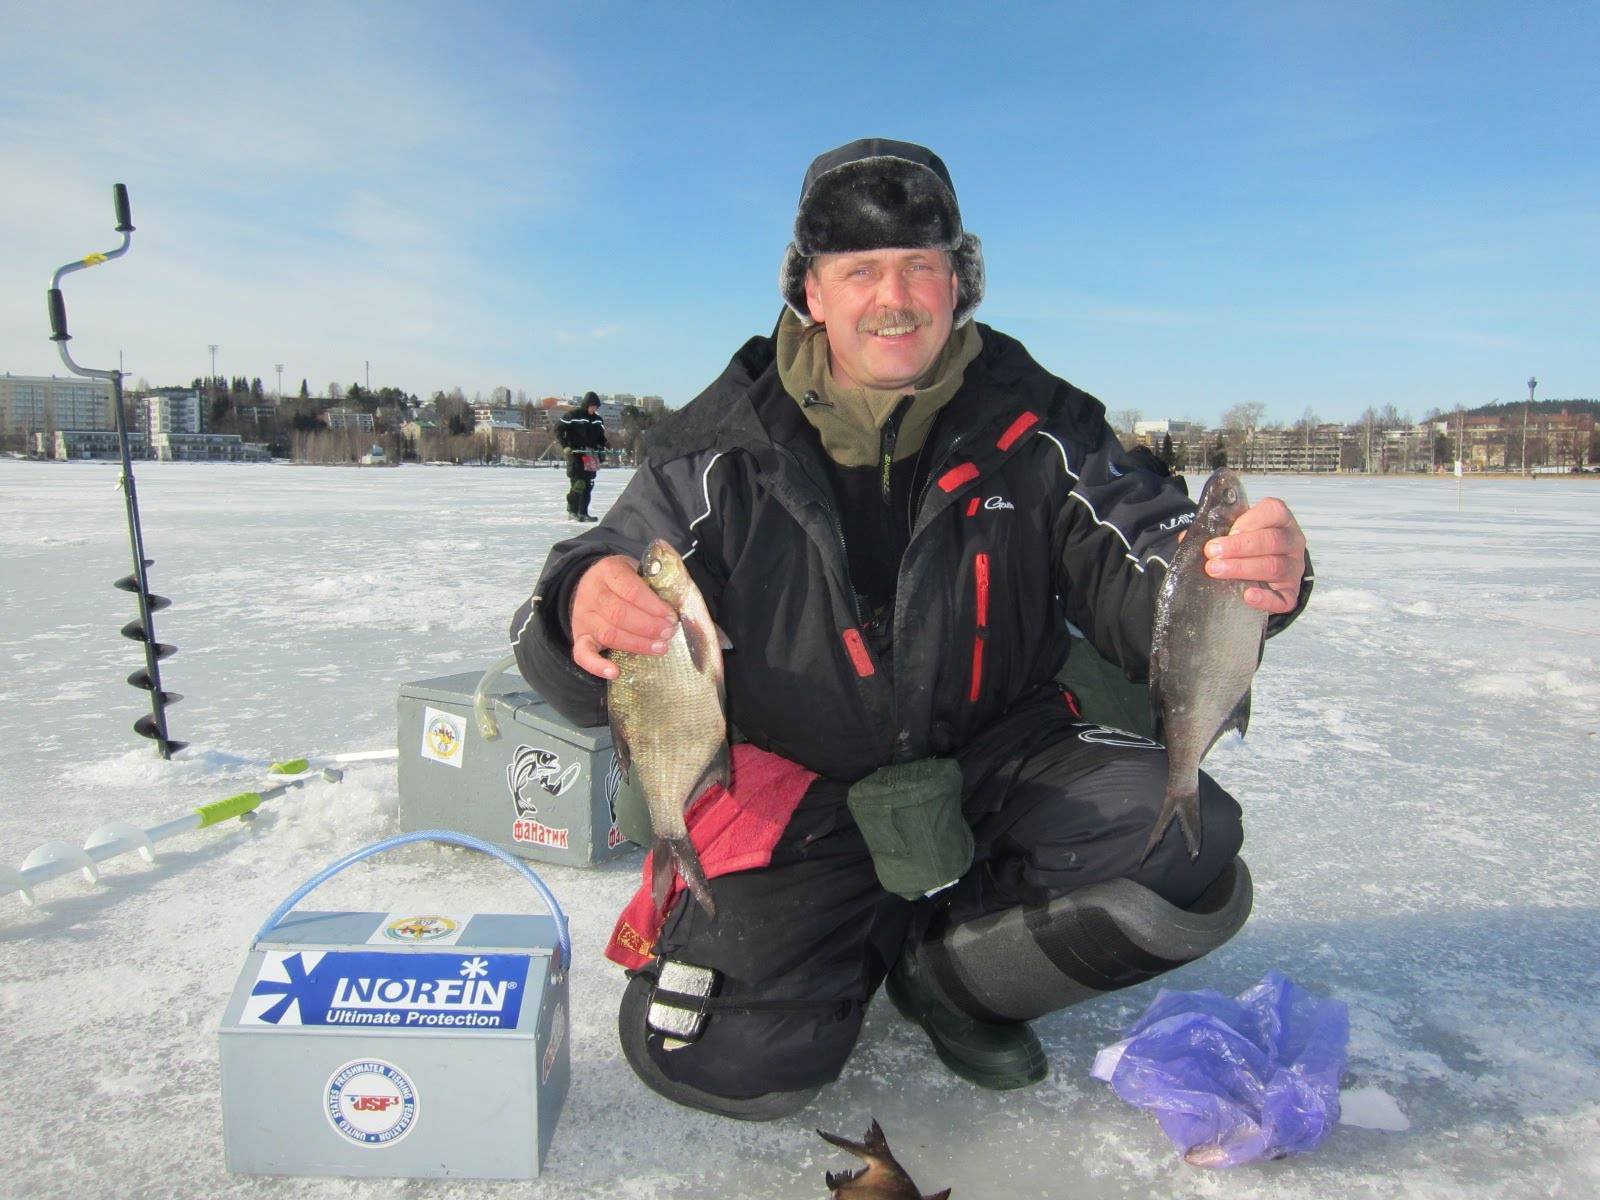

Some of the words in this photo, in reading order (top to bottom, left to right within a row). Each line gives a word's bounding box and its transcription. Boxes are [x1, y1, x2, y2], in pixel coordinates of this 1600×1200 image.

[326, 1010, 400, 1024] Ultimate
[406, 1011, 500, 1026] Protection
[335, 1063, 385, 1087] FRESHWATER
[387, 1070, 413, 1100] FISHING
[330, 1089, 343, 1118] STATES
[339, 1120, 367, 1141] UNITED
[380, 1103, 414, 1141] FEDERATION
